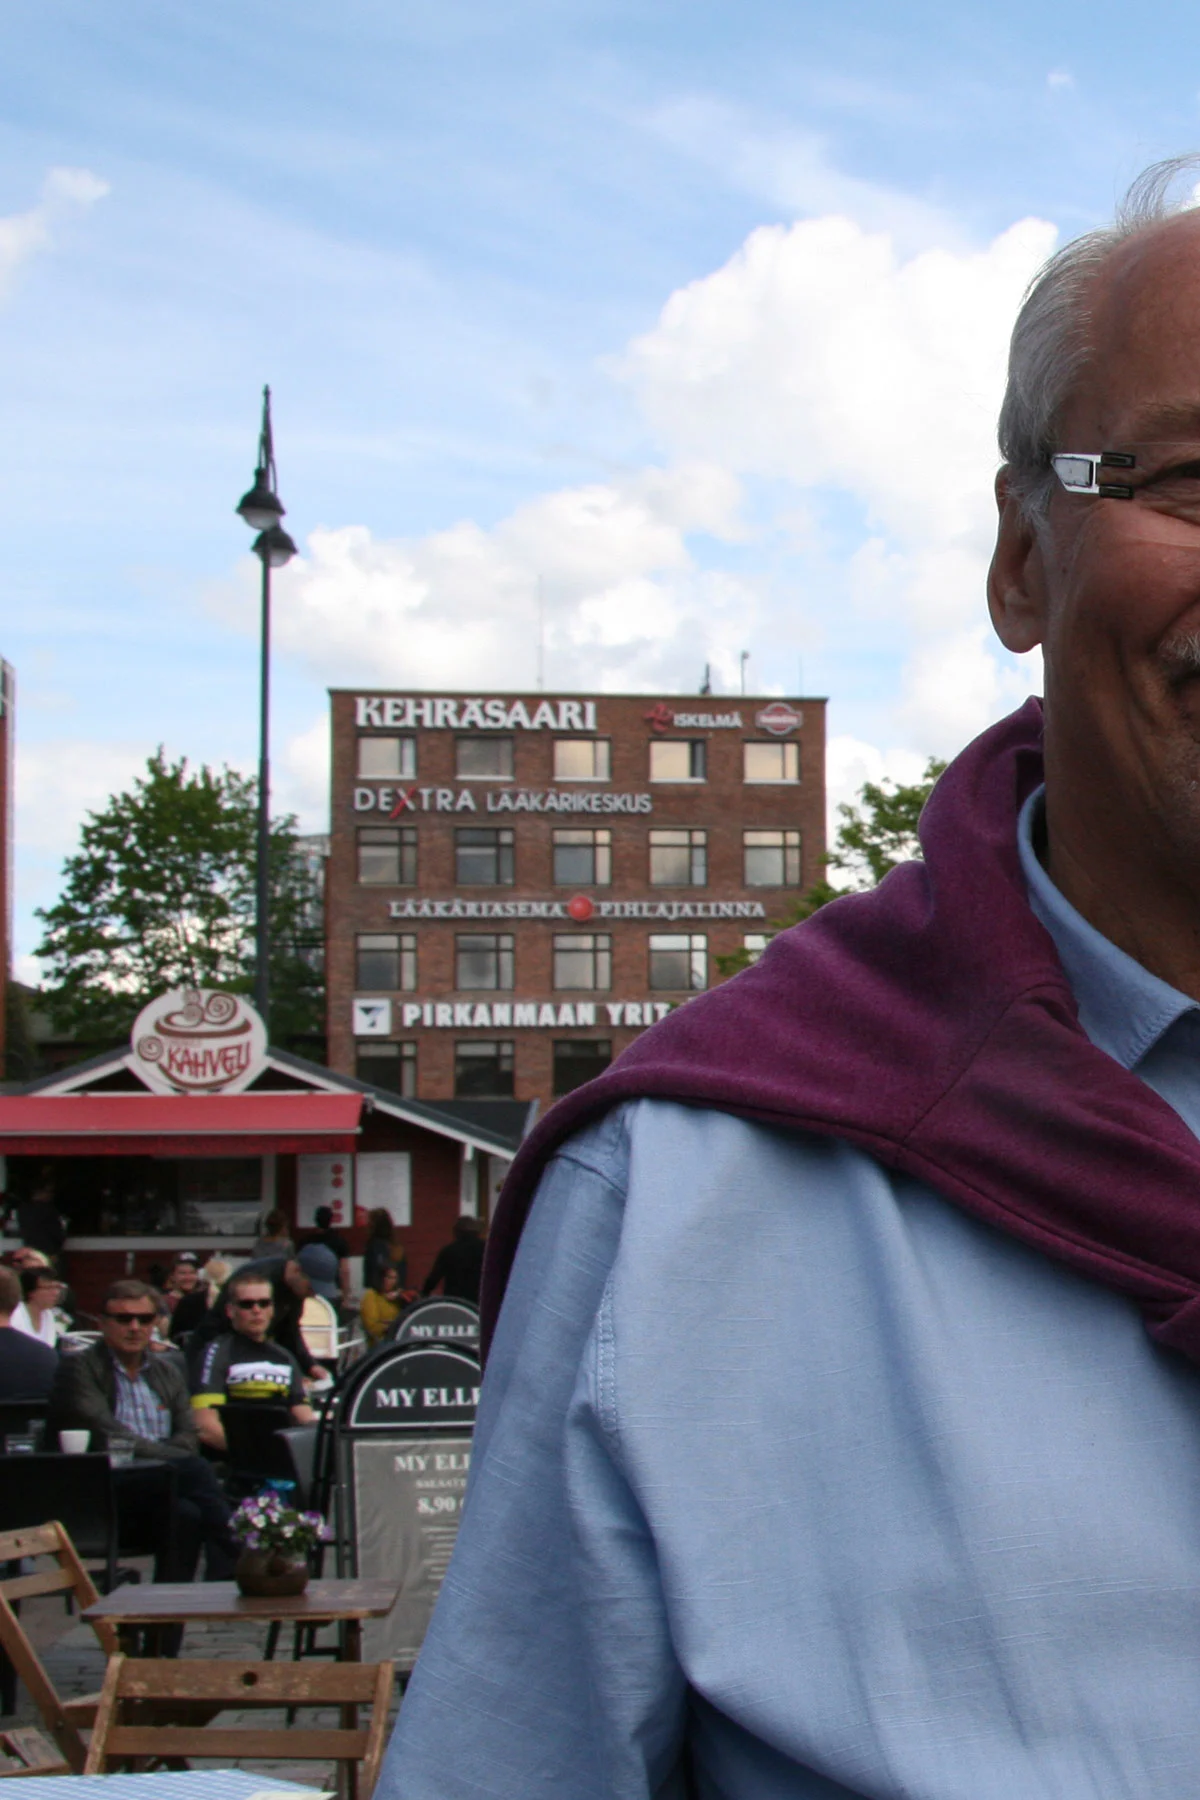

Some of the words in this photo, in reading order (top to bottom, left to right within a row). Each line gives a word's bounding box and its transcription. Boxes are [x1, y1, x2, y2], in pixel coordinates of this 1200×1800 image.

[355, 697, 597, 731] KEHRÄSAARI
[354, 787, 476, 818] DEXTRA
[486, 788, 653, 813] LÄÄKÄRIKESKUS
[390, 899, 566, 918] LÄÄKÄRIASEMA
[600, 900, 766, 921] PIHLAJALINNA
[403, 1002, 596, 1027] PIRKANMAAN
[411, 1325, 434, 1337] MY
[376, 1388, 416, 1408] MY
[394, 1455, 429, 1472] MY
